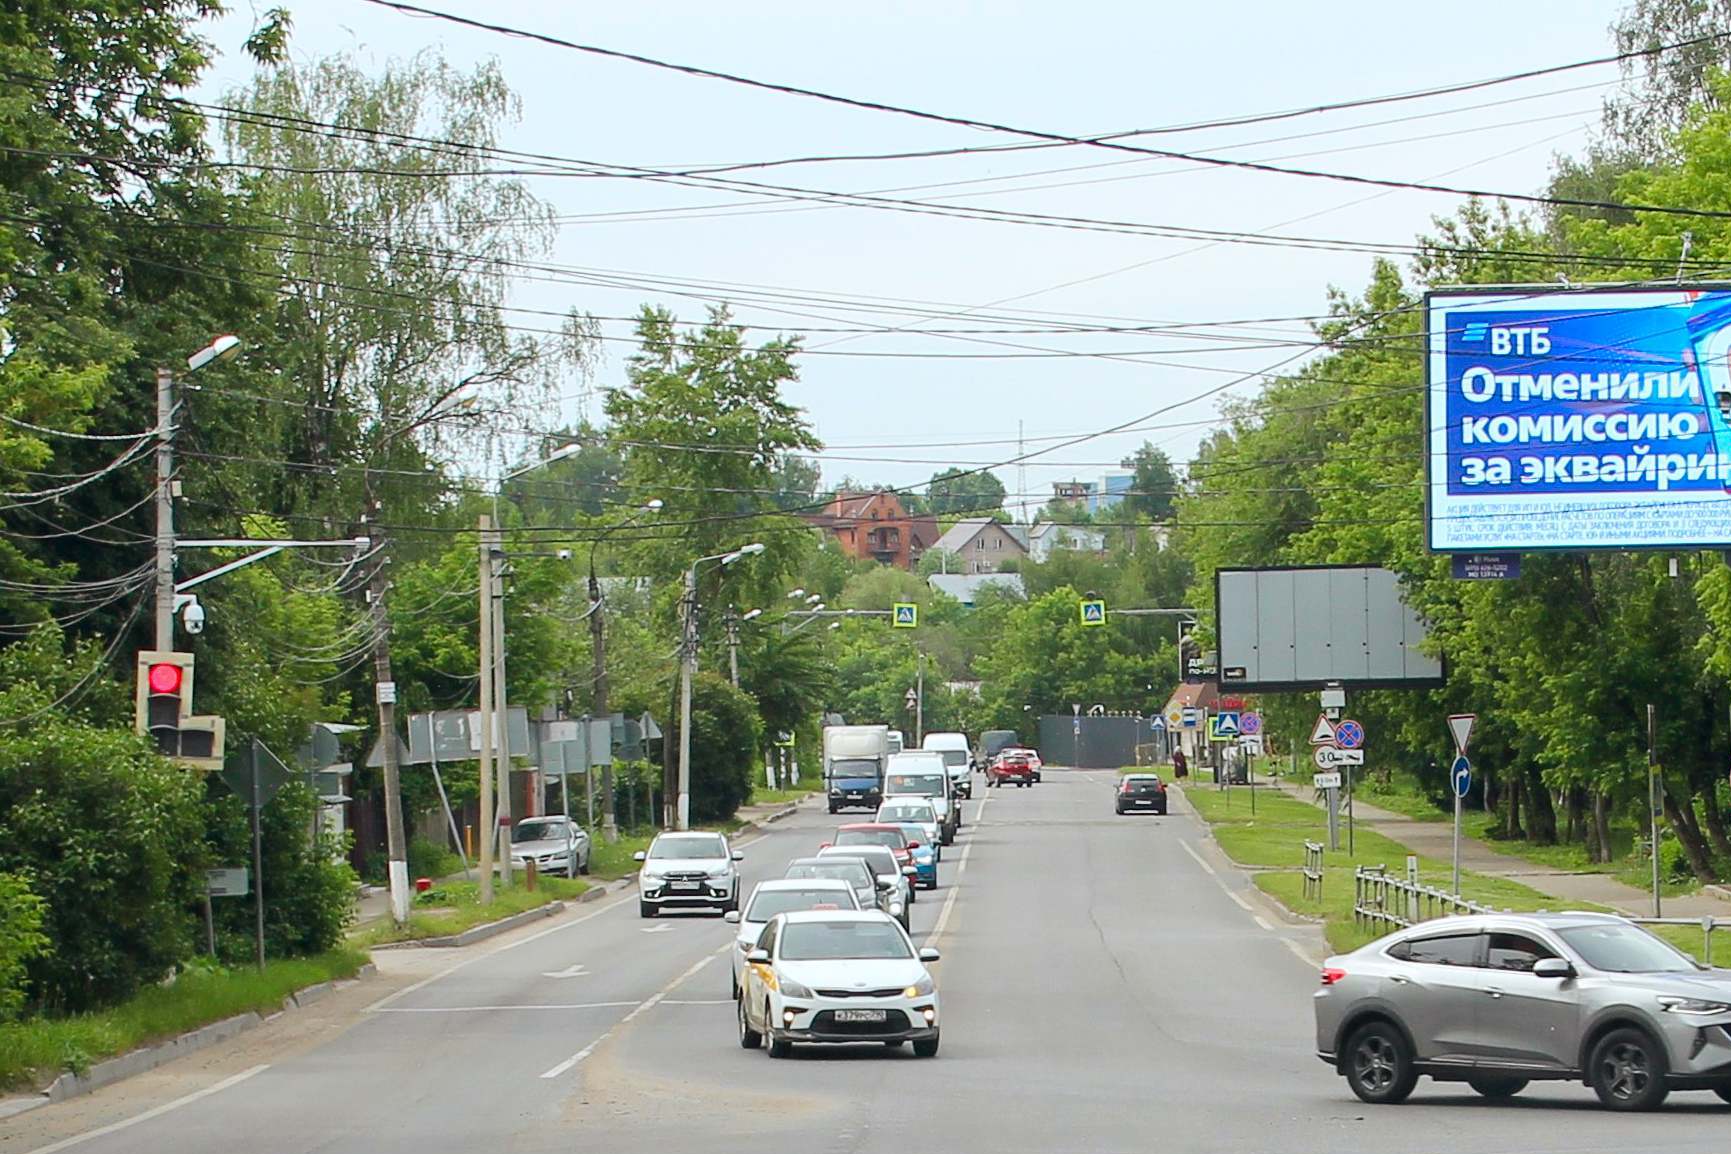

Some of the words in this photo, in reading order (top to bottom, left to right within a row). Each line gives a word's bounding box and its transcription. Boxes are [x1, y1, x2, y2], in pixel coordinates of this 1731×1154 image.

[1491, 327, 1551, 355] ВТБ
[1461, 366, 1699, 402] Отменили
[1462, 412, 1698, 443] комиссию
[1461, 456, 1512, 485] за
[1319, 752, 1335, 763] 30
